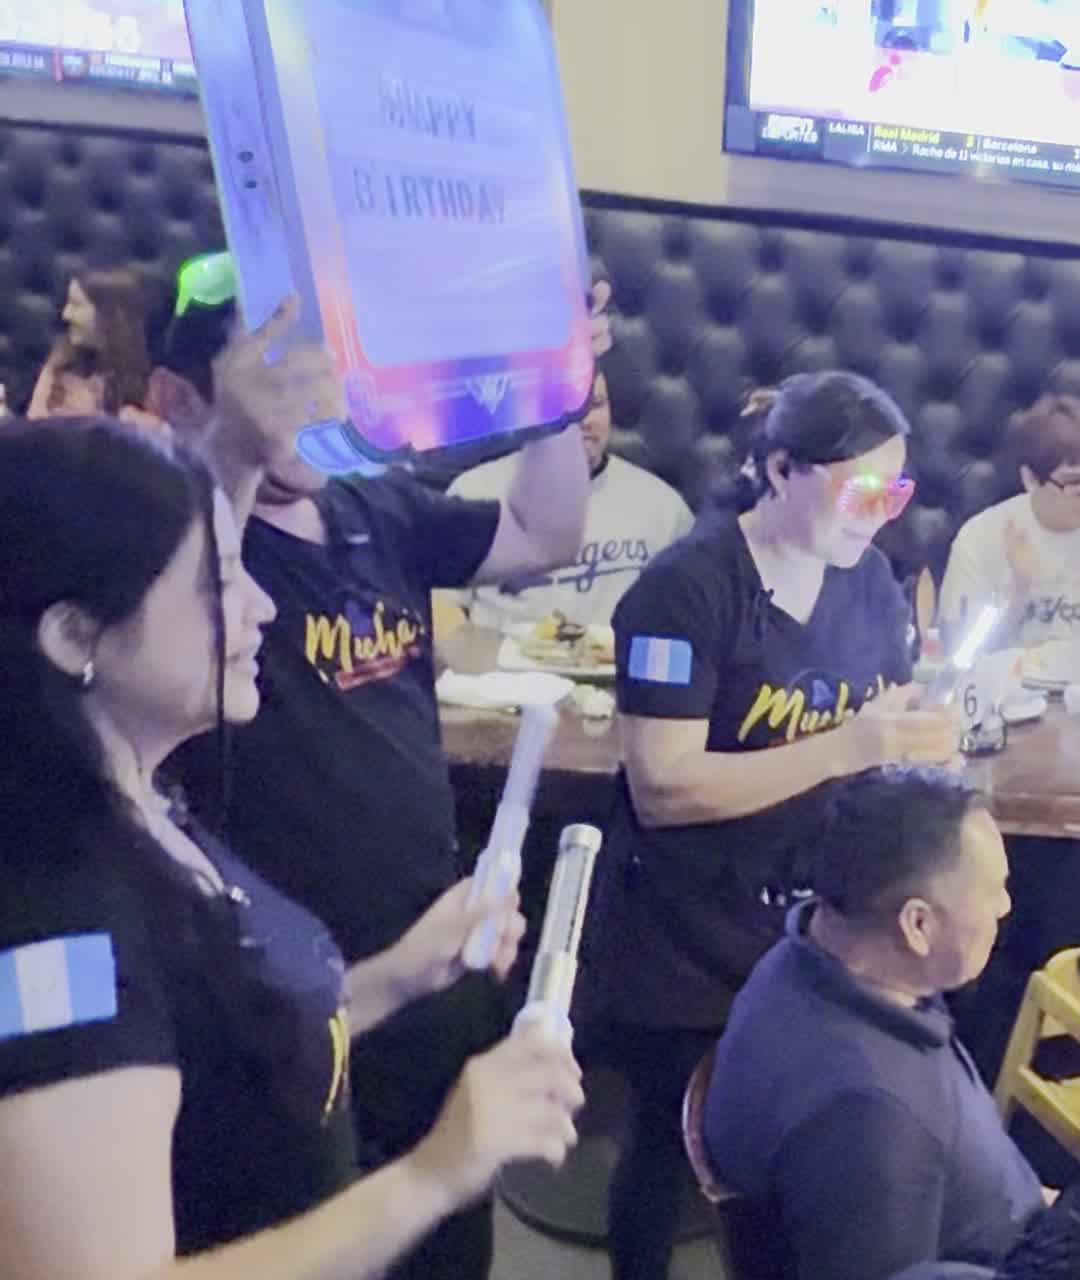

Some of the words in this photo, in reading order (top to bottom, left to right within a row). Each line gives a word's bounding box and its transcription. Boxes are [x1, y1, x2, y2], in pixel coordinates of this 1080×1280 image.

[874, 125, 898, 139] Real
[901, 128, 939, 144] Madrid
[983, 139, 1037, 154] Barcelona
[575, 539, 648, 593] gers
[964, 684, 977, 717] 6
